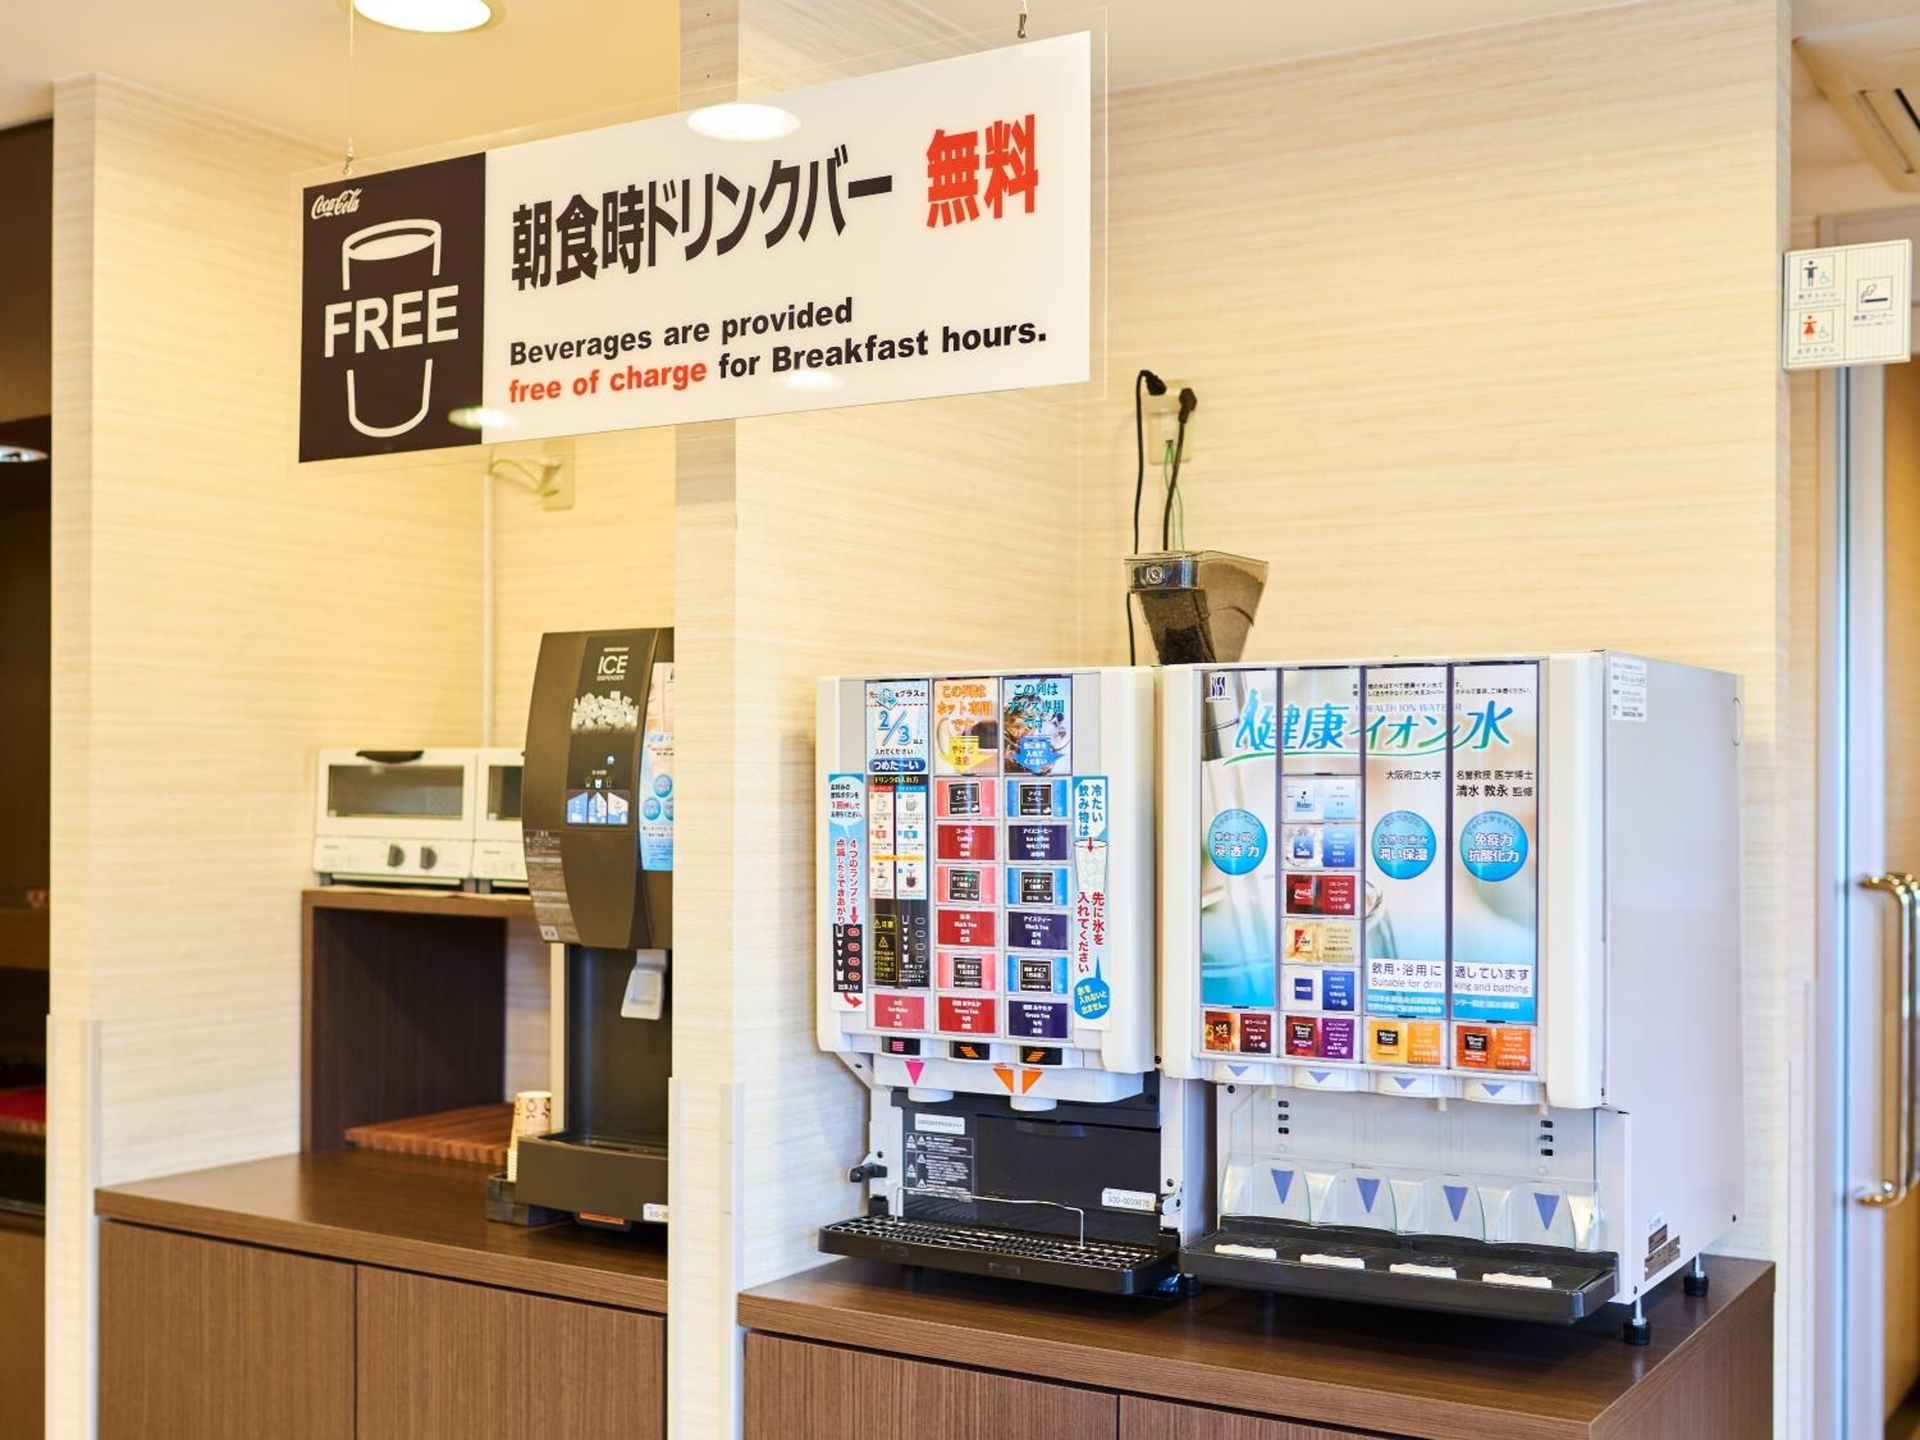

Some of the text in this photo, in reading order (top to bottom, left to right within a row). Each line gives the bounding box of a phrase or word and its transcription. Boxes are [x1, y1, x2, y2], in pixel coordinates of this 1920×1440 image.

[512, 113, 1038, 291] 朝食時ドリンクバー 無料
[324, 284, 459, 358] FREE
[510, 296, 853, 366] Beverages are provided
[509, 322, 1047, 403] free of charge for Breakfast hours.
[598, 655, 629, 675] ICE
[942, 685, 987, 699] この列は
[1013, 683, 1058, 697] この列は
[1386, 770, 1442, 781] 大阪府立大学
[1456, 770, 1534, 781] 名誉教授 医学博士
[1456, 785, 1480, 797] 清水
[1078, 784, 1089, 837] 飲み物は
[1092, 784, 1103, 824] 冷たい
[1474, 833, 1513, 847] 免疫力
[1468, 848, 1519, 863] 抗酸化力
[1092, 891, 1105, 946] 先に氷を
[1077, 891, 1090, 974] 入れてください
[1372, 977, 1406, 988] Suitable
[1407, 978, 1421, 988] for
[1474, 982, 1491, 992] and
[1493, 983, 1530, 995] bathing
